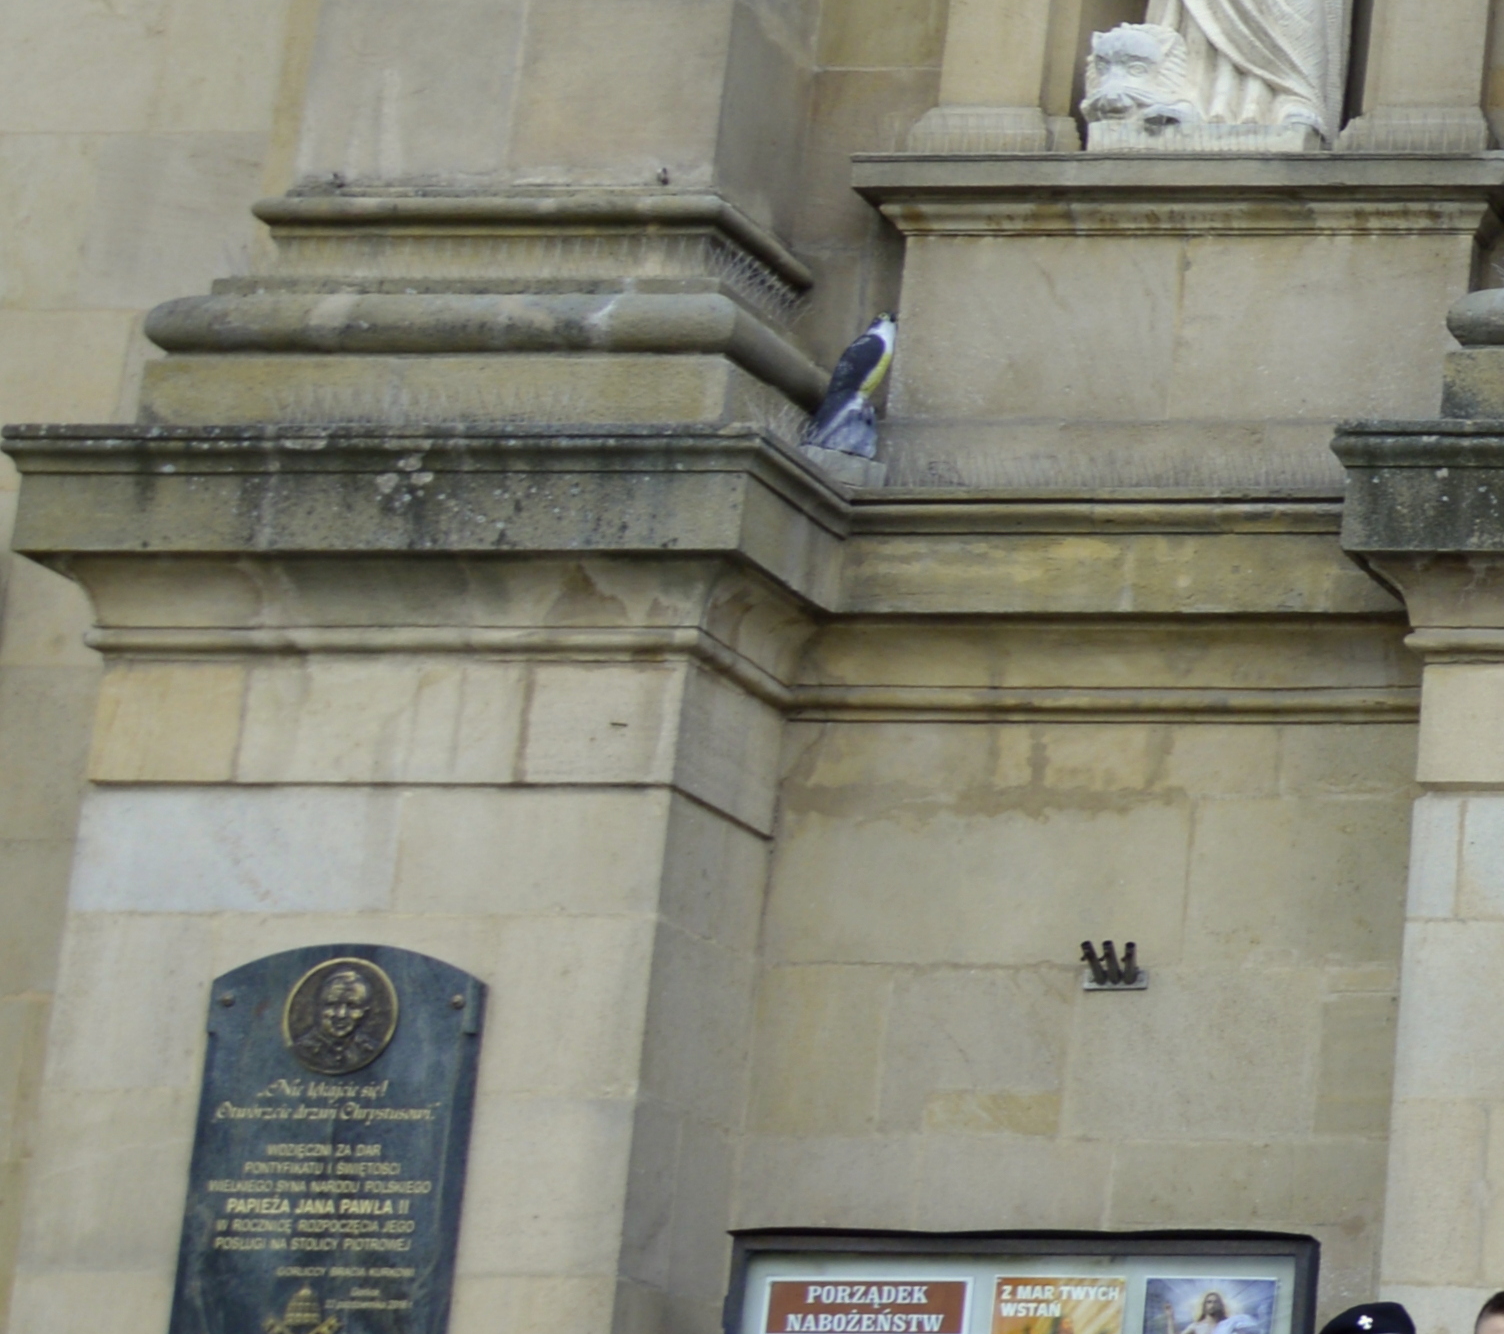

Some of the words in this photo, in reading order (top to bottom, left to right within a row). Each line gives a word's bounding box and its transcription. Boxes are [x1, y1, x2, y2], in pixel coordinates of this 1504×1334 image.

[335, 1144, 351, 1156] ZA
[356, 1144, 382, 1156] DAR
[226, 1195, 291, 1214] PAPIEŻA
[294, 1198, 335, 1214] JANA
[340, 1198, 393, 1214] PAWŁA
[398, 1199, 411, 1214] II
[806, 1285, 928, 1308] PORZĄDEK
[1001, 1285, 1013, 1299] Z
[1000, 1299, 1062, 1317] WSTAŃ
[785, 1309, 945, 1333] NABOŻEŃSTW
